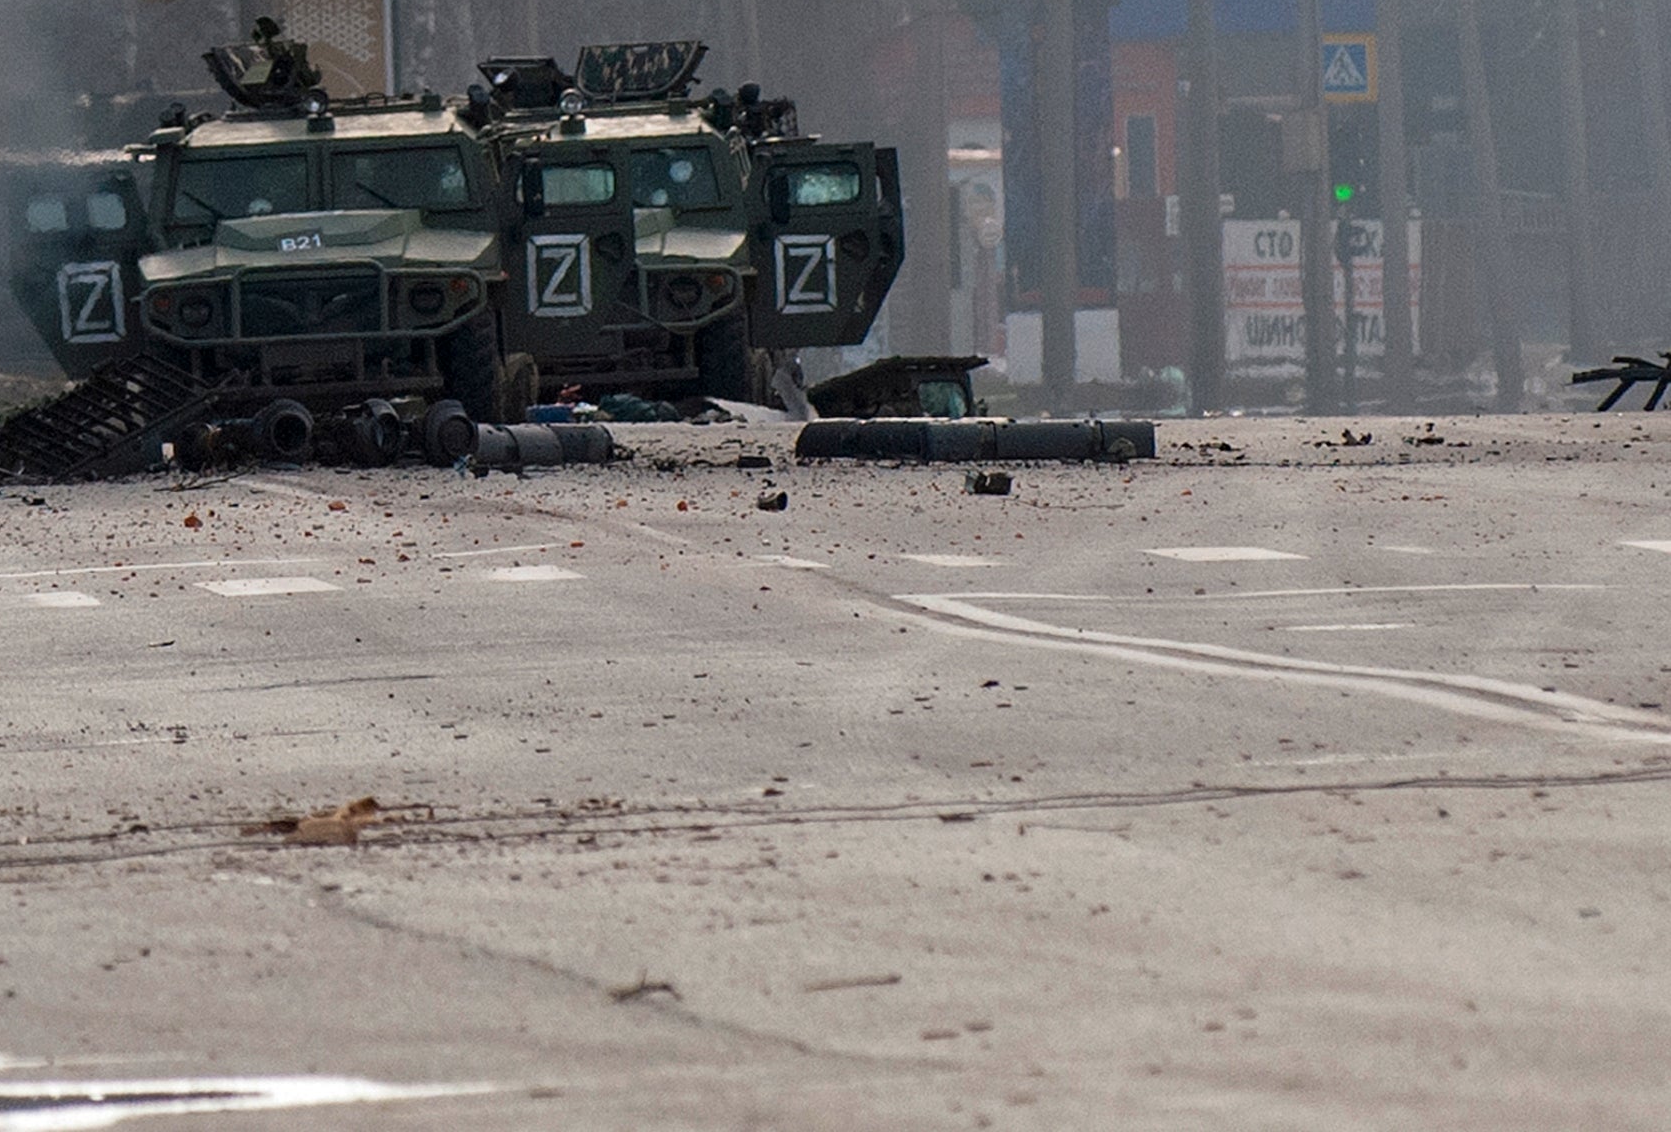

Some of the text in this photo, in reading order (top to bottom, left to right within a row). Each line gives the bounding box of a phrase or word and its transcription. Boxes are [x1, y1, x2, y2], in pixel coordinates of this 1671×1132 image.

[281, 234, 321, 252] B21
[1254, 231, 1294, 259] СТО
[76, 274, 110, 330] Z
[542, 247, 578, 303] Z
[788, 247, 825, 303] Z
